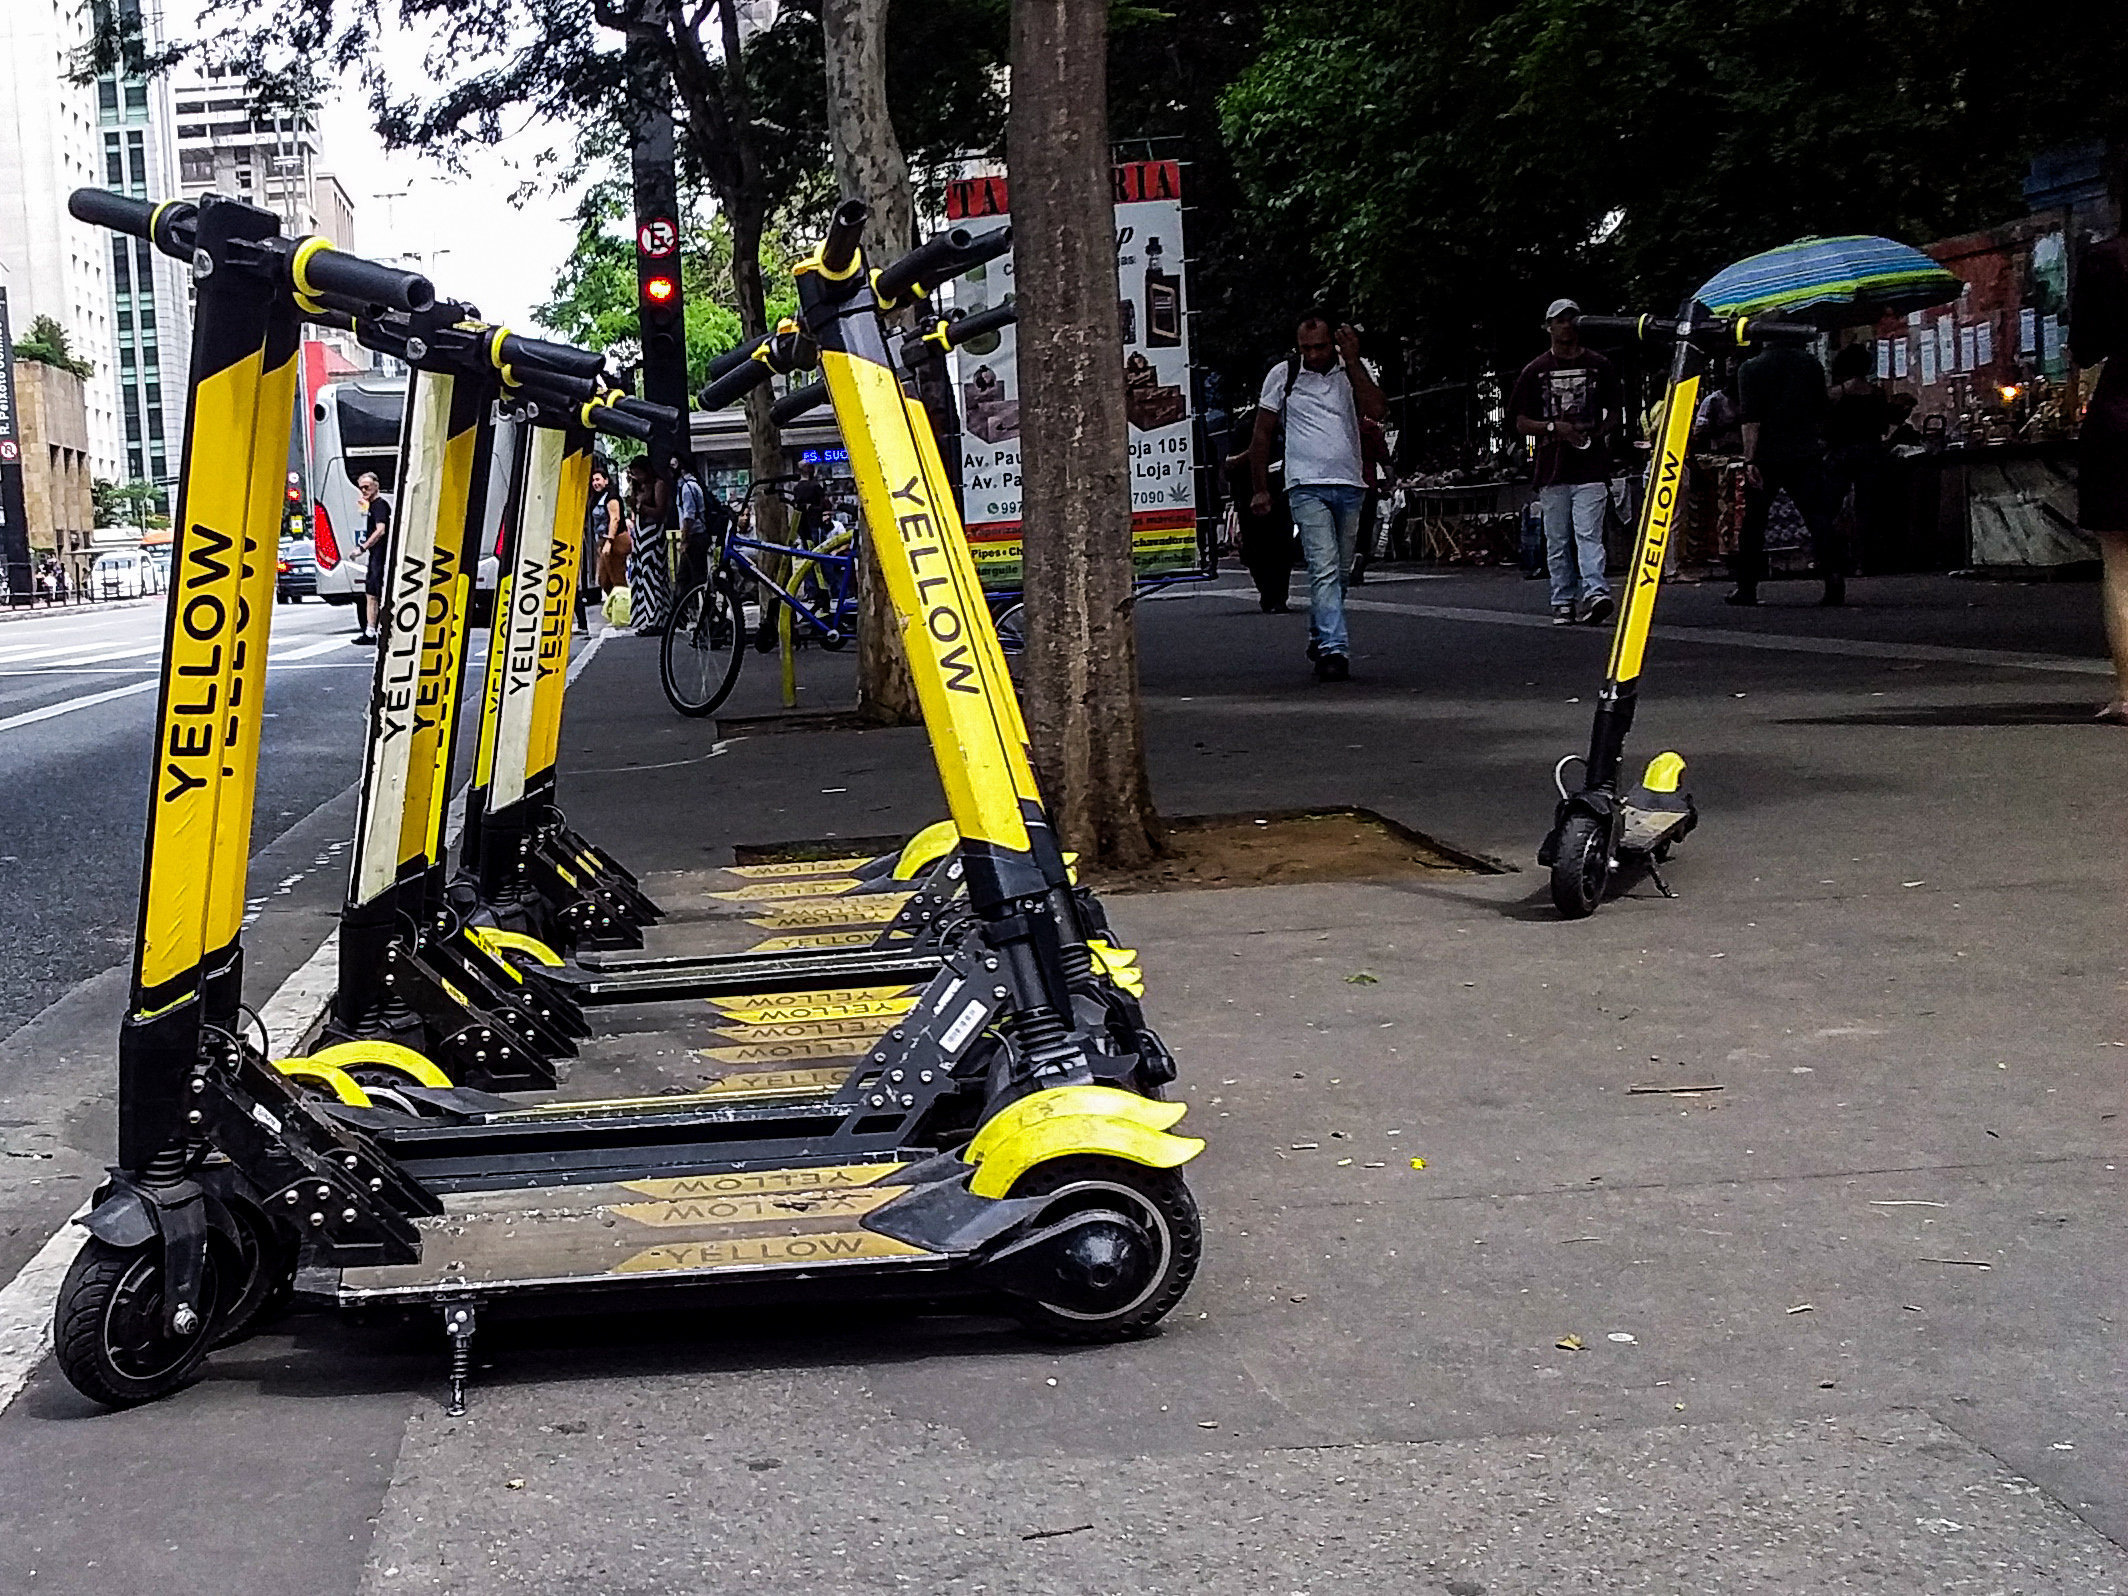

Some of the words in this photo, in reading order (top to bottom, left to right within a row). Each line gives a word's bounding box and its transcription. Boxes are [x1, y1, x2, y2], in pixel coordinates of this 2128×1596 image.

[964, 453, 989, 468] Av.
[995, 451, 1021, 466] Pau
[1129, 440, 1151, 459] oja
[1158, 437, 1188, 454] 105
[972, 475, 997, 490] Av.
[1003, 472, 1022, 487] Pa
[1136, 461, 1171, 480] Loja
[1177, 459, 1186, 475] 7
[1133, 490, 1164, 505] 7090
[1640, 451, 1680, 587] YELLOW
[892, 476, 980, 694] YELLOW
[536, 539, 569, 681] YELLOW
[412, 545, 455, 735] YELLOW
[509, 559, 545, 695] YELLOW
[164, 523, 233, 803] YELLOW
[382, 555, 426, 743] YELLOW
[753, 863, 845, 874] YELLOW
[746, 991, 873, 1008] YELLOW
[759, 1003, 893, 1022] YELLOW
[751, 1020, 888, 1038] YELLOW
[743, 1069, 850, 1087] YELLO
[671, 1171, 853, 1194] YELLOW
[665, 1237, 864, 1264] YELLOW
